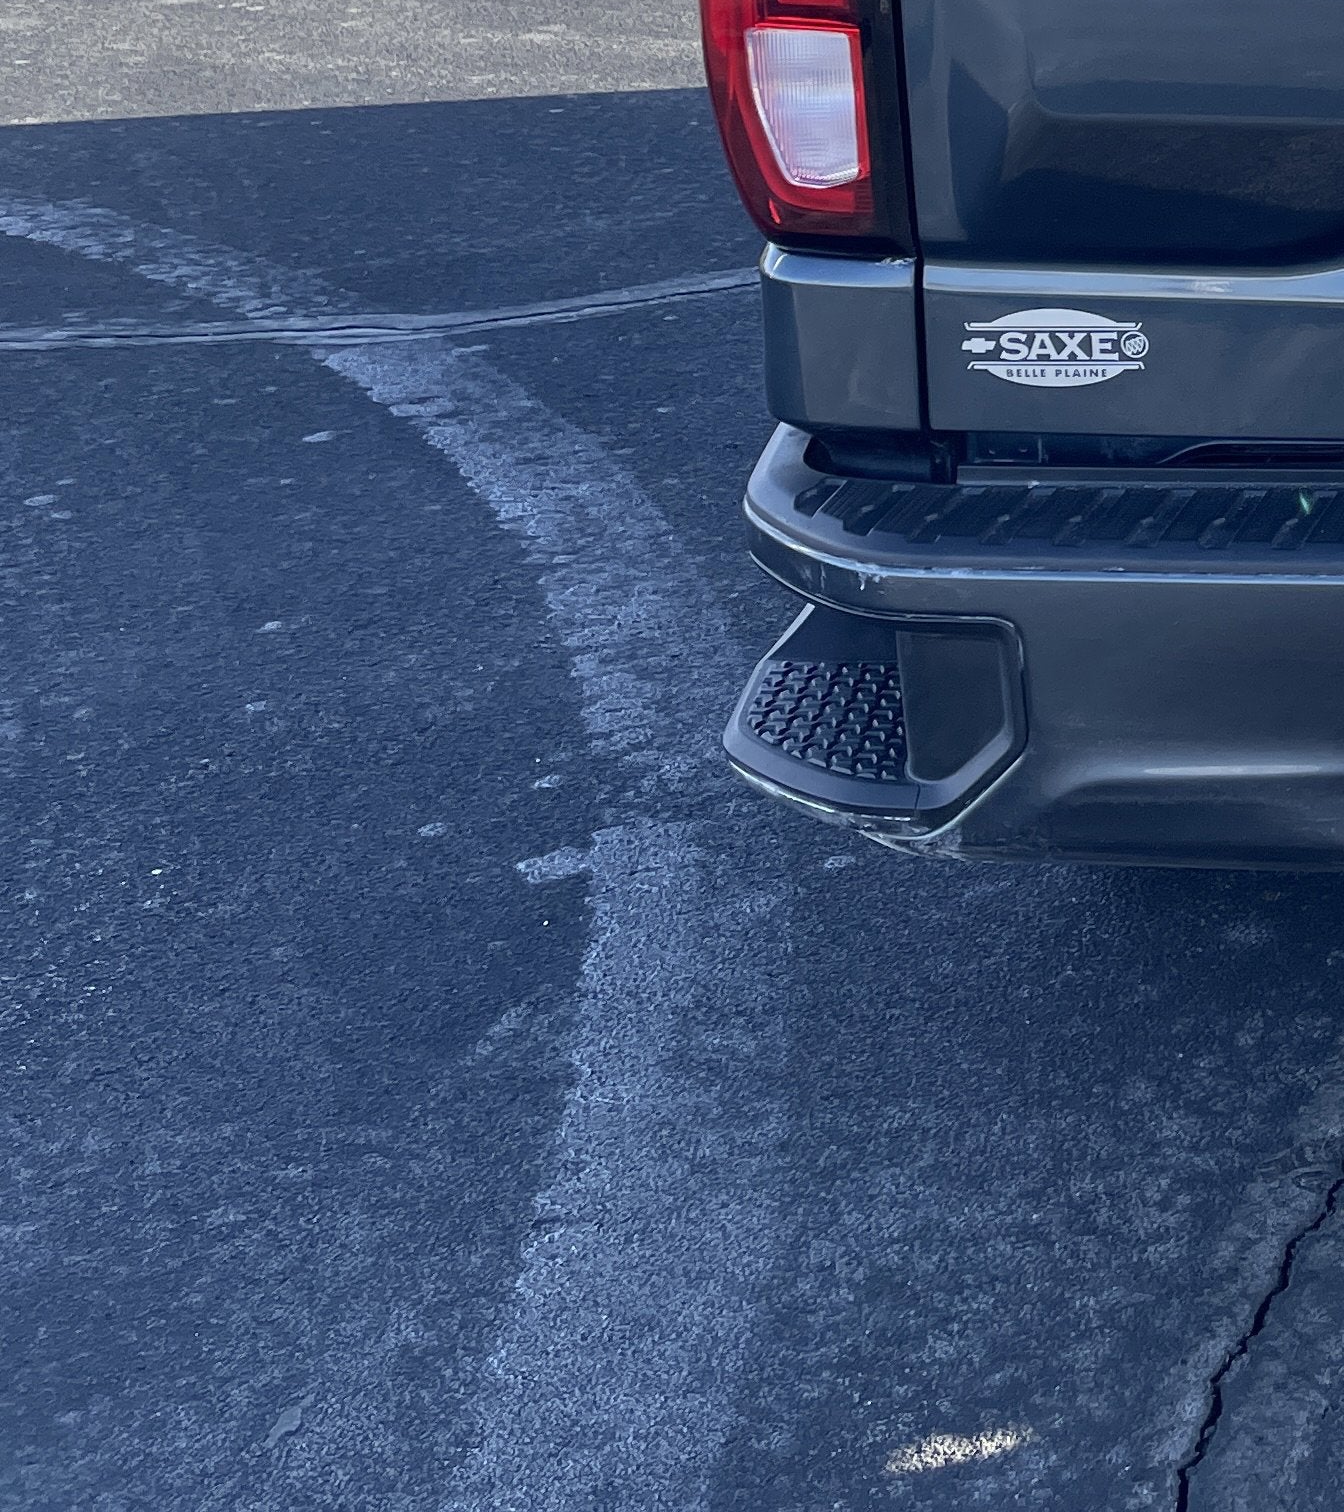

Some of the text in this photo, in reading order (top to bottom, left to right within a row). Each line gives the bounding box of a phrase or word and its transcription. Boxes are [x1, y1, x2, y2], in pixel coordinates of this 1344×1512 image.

[999, 331, 1120, 362] SAXE
[1006, 368, 1108, 378] BELLE PLAINE
